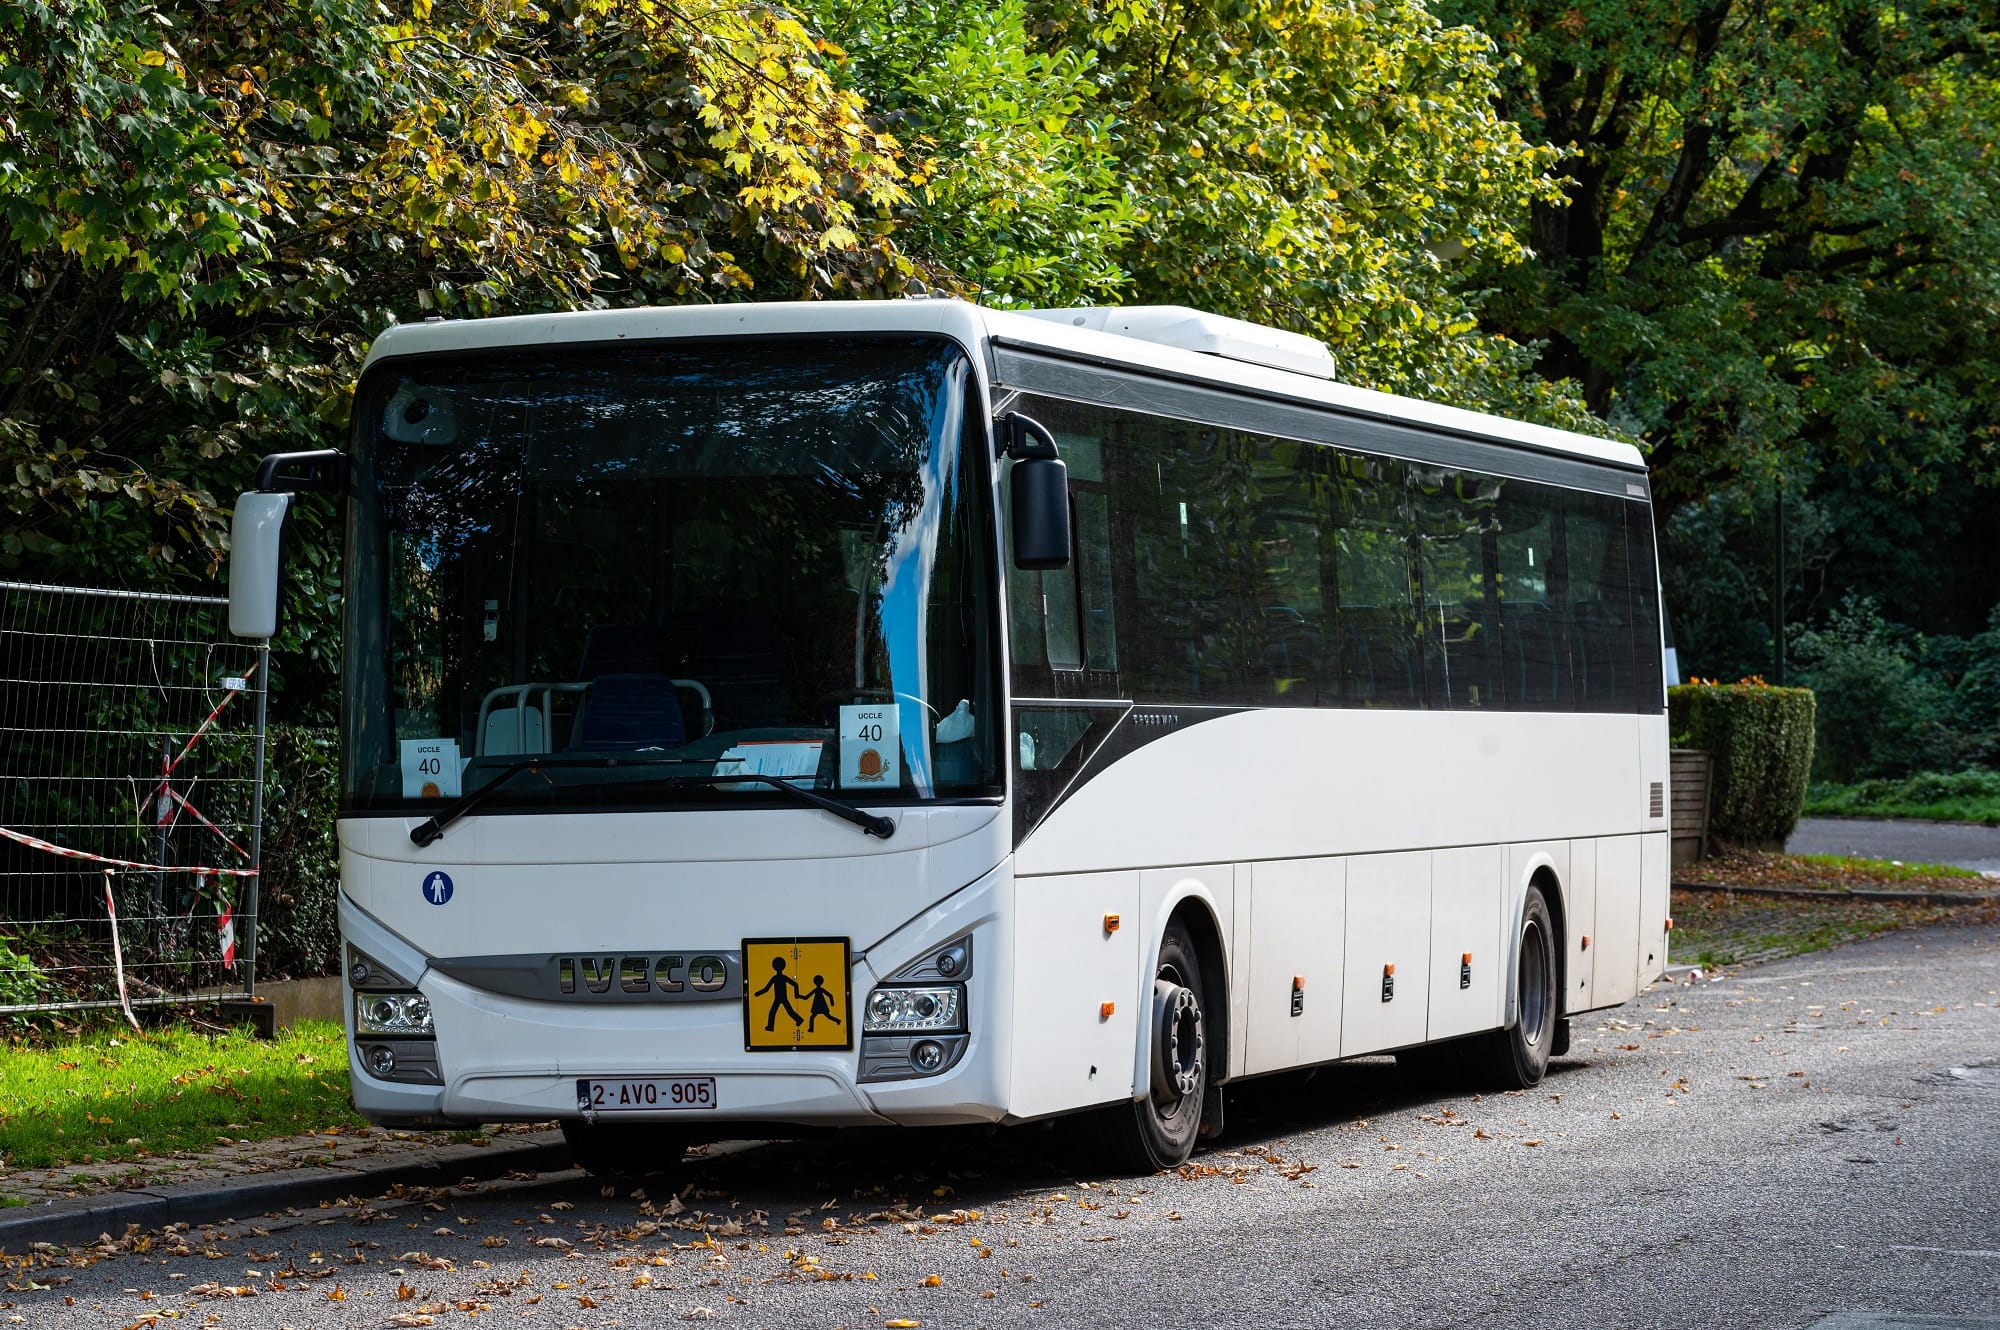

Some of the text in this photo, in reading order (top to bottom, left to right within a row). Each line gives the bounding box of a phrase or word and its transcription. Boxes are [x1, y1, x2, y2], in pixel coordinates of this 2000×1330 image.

[858, 724, 882, 741] 40
[418, 758, 440, 775] 40
[560, 956, 727, 993] IVECO
[593, 1083, 710, 1104] 2-AVQ-905
